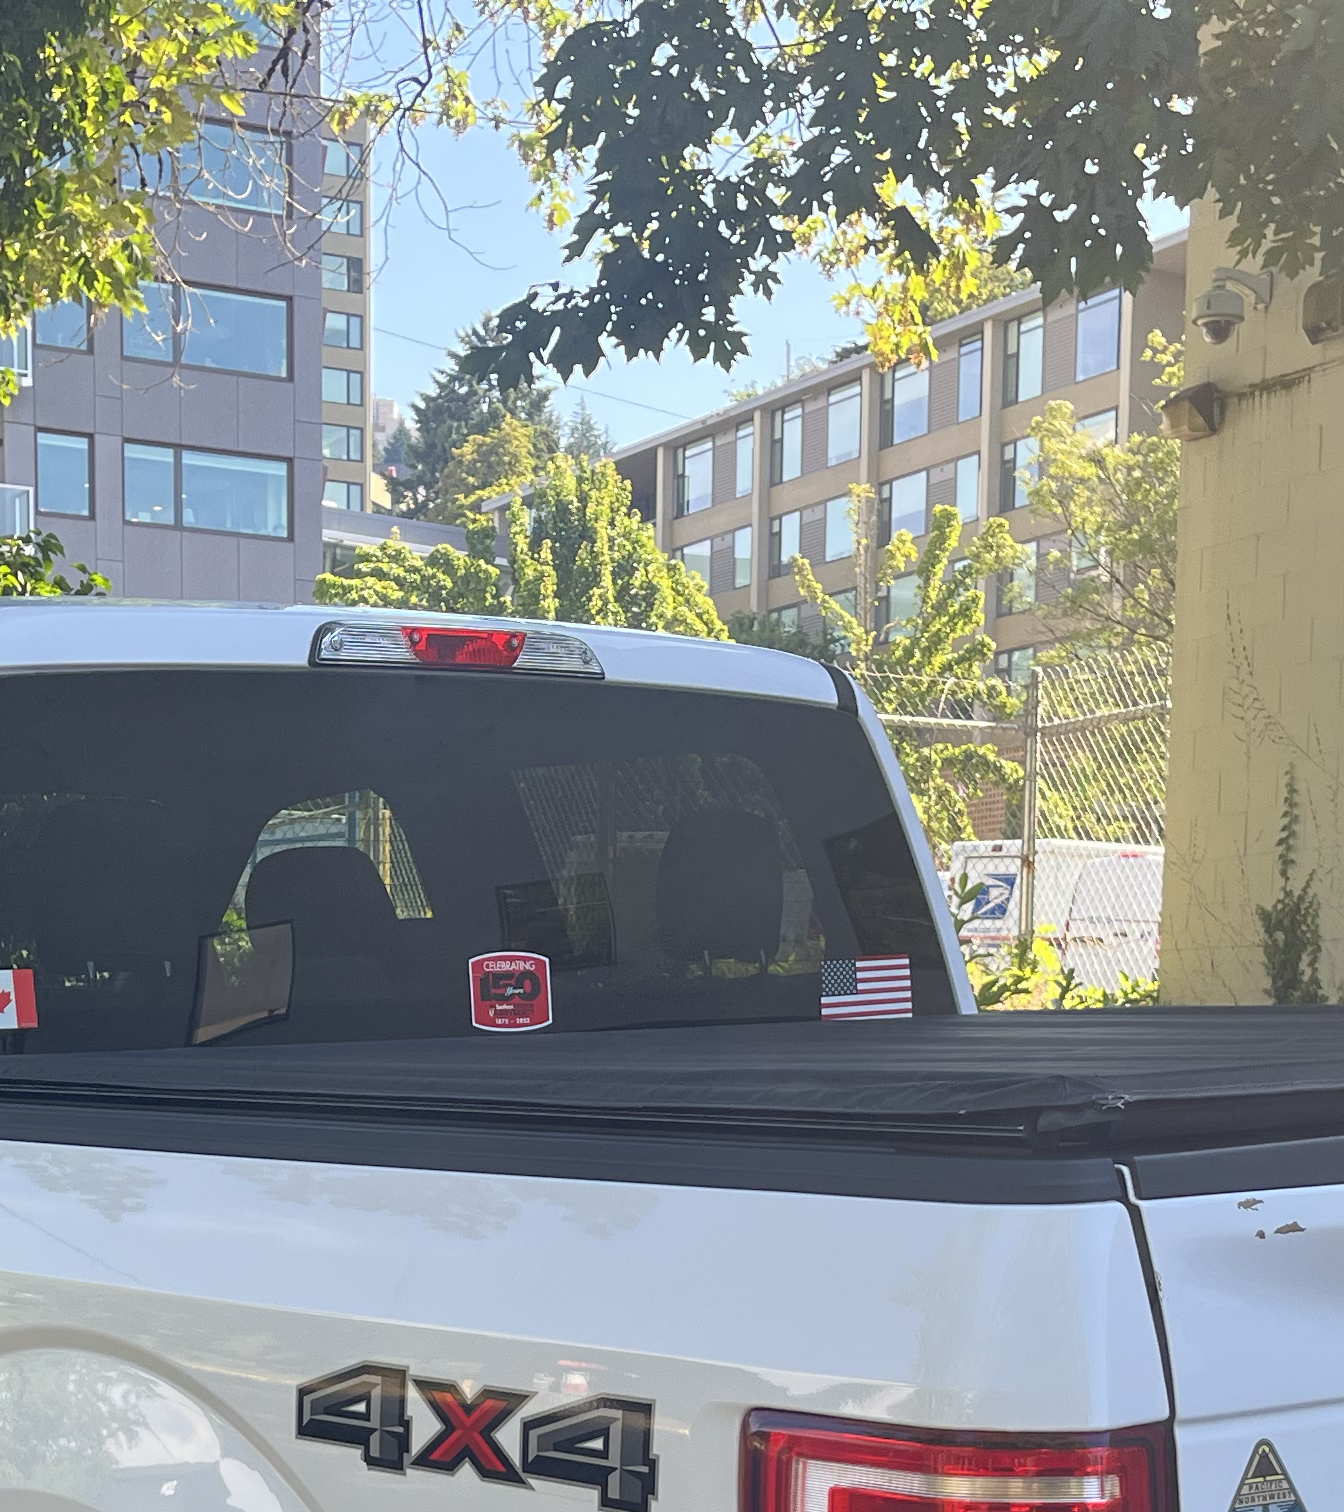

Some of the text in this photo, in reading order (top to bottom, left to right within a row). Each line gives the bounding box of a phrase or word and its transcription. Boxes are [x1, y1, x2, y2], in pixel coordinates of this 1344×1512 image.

[483, 960, 536, 972] CELEBRATING
[479, 970, 541, 1002] 150
[1247, 1480, 1284, 1491] PACIFIC
[1237, 1490, 1294, 1506] NORTHWEST
